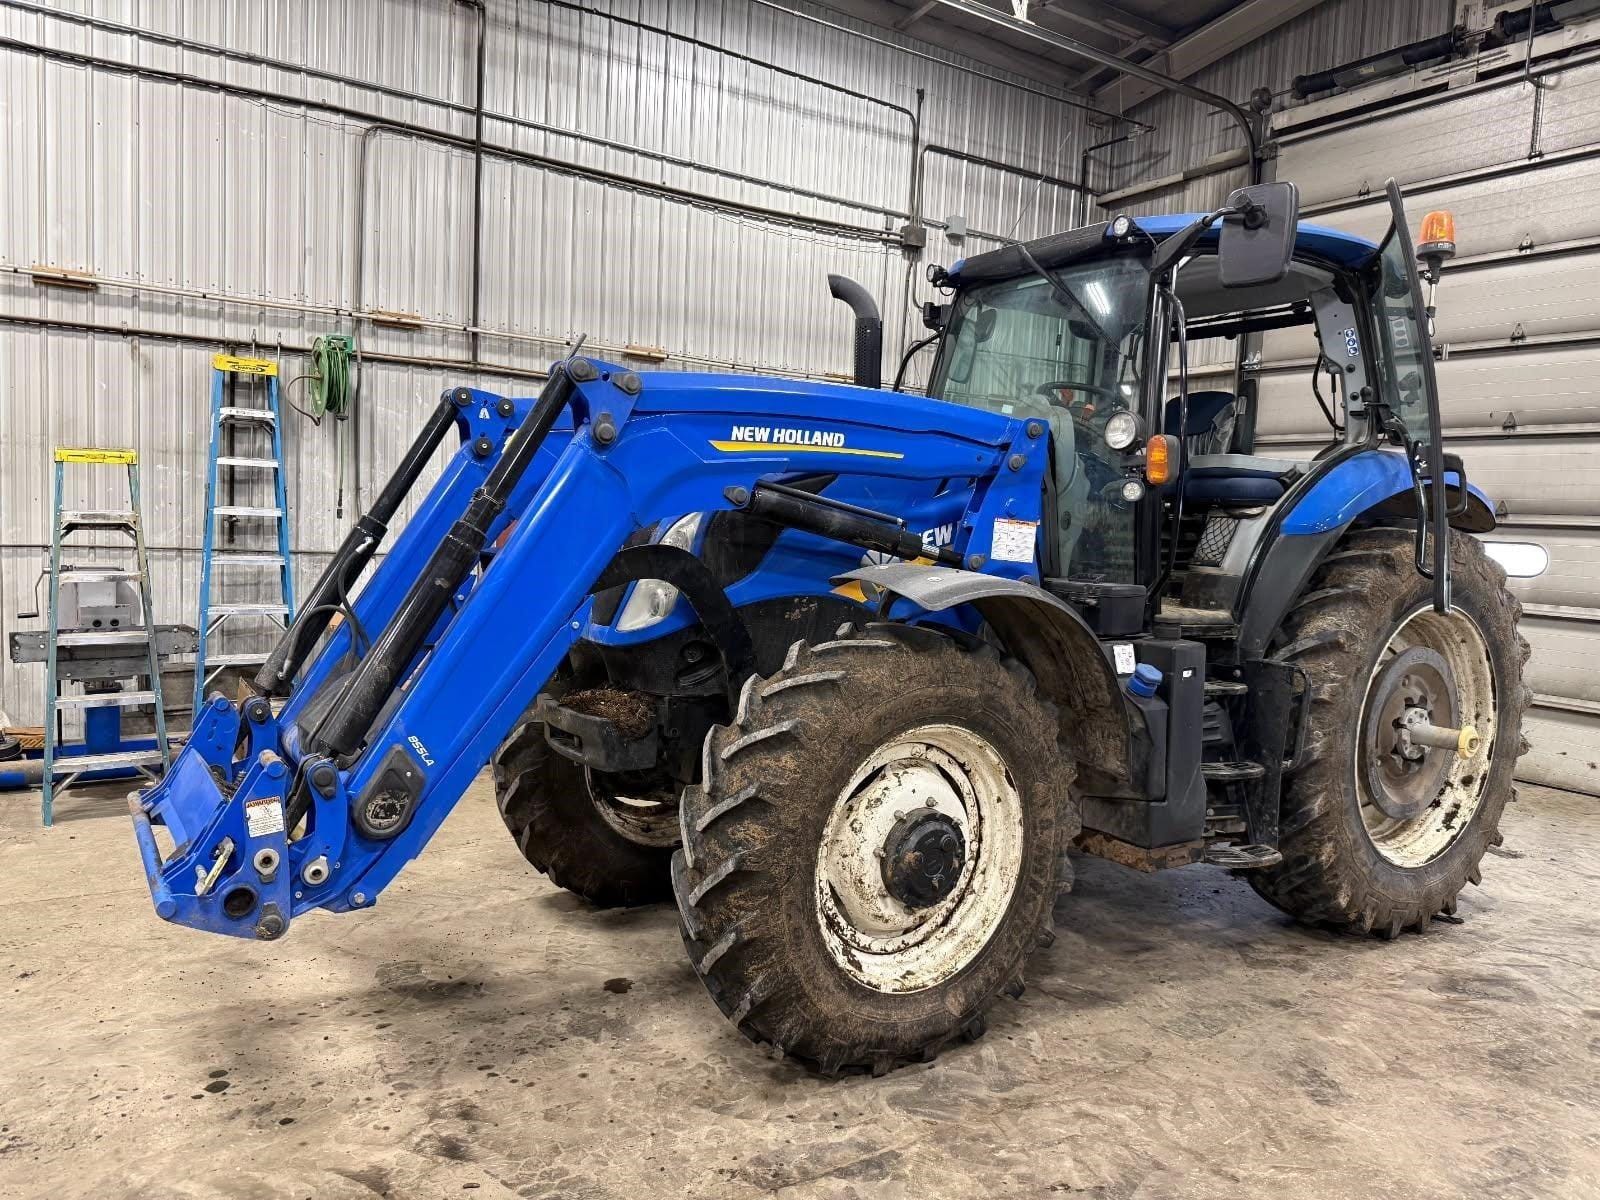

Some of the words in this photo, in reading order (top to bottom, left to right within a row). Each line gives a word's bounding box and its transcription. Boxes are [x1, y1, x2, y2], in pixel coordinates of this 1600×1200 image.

[731, 425, 770, 442] NEW
[773, 429, 845, 447] HOLLAND
[918, 523, 954, 547] EW
[407, 735, 435, 767] 855LA
